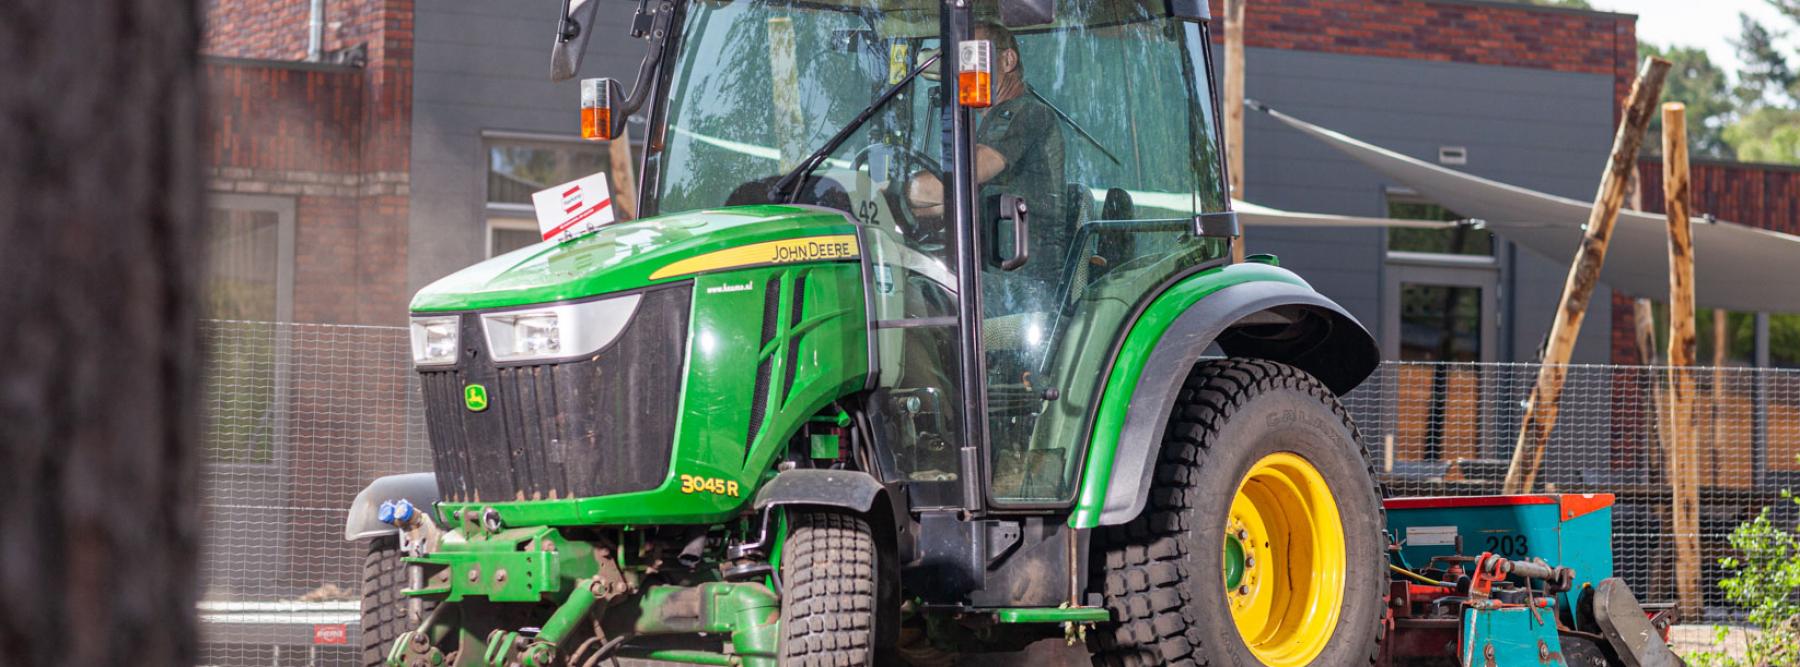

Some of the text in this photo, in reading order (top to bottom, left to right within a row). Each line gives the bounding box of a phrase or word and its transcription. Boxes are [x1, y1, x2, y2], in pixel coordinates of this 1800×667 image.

[859, 200, 880, 225] 42
[772, 242, 850, 261] JOHN DEERE
[1486, 535, 1528, 557] 203
